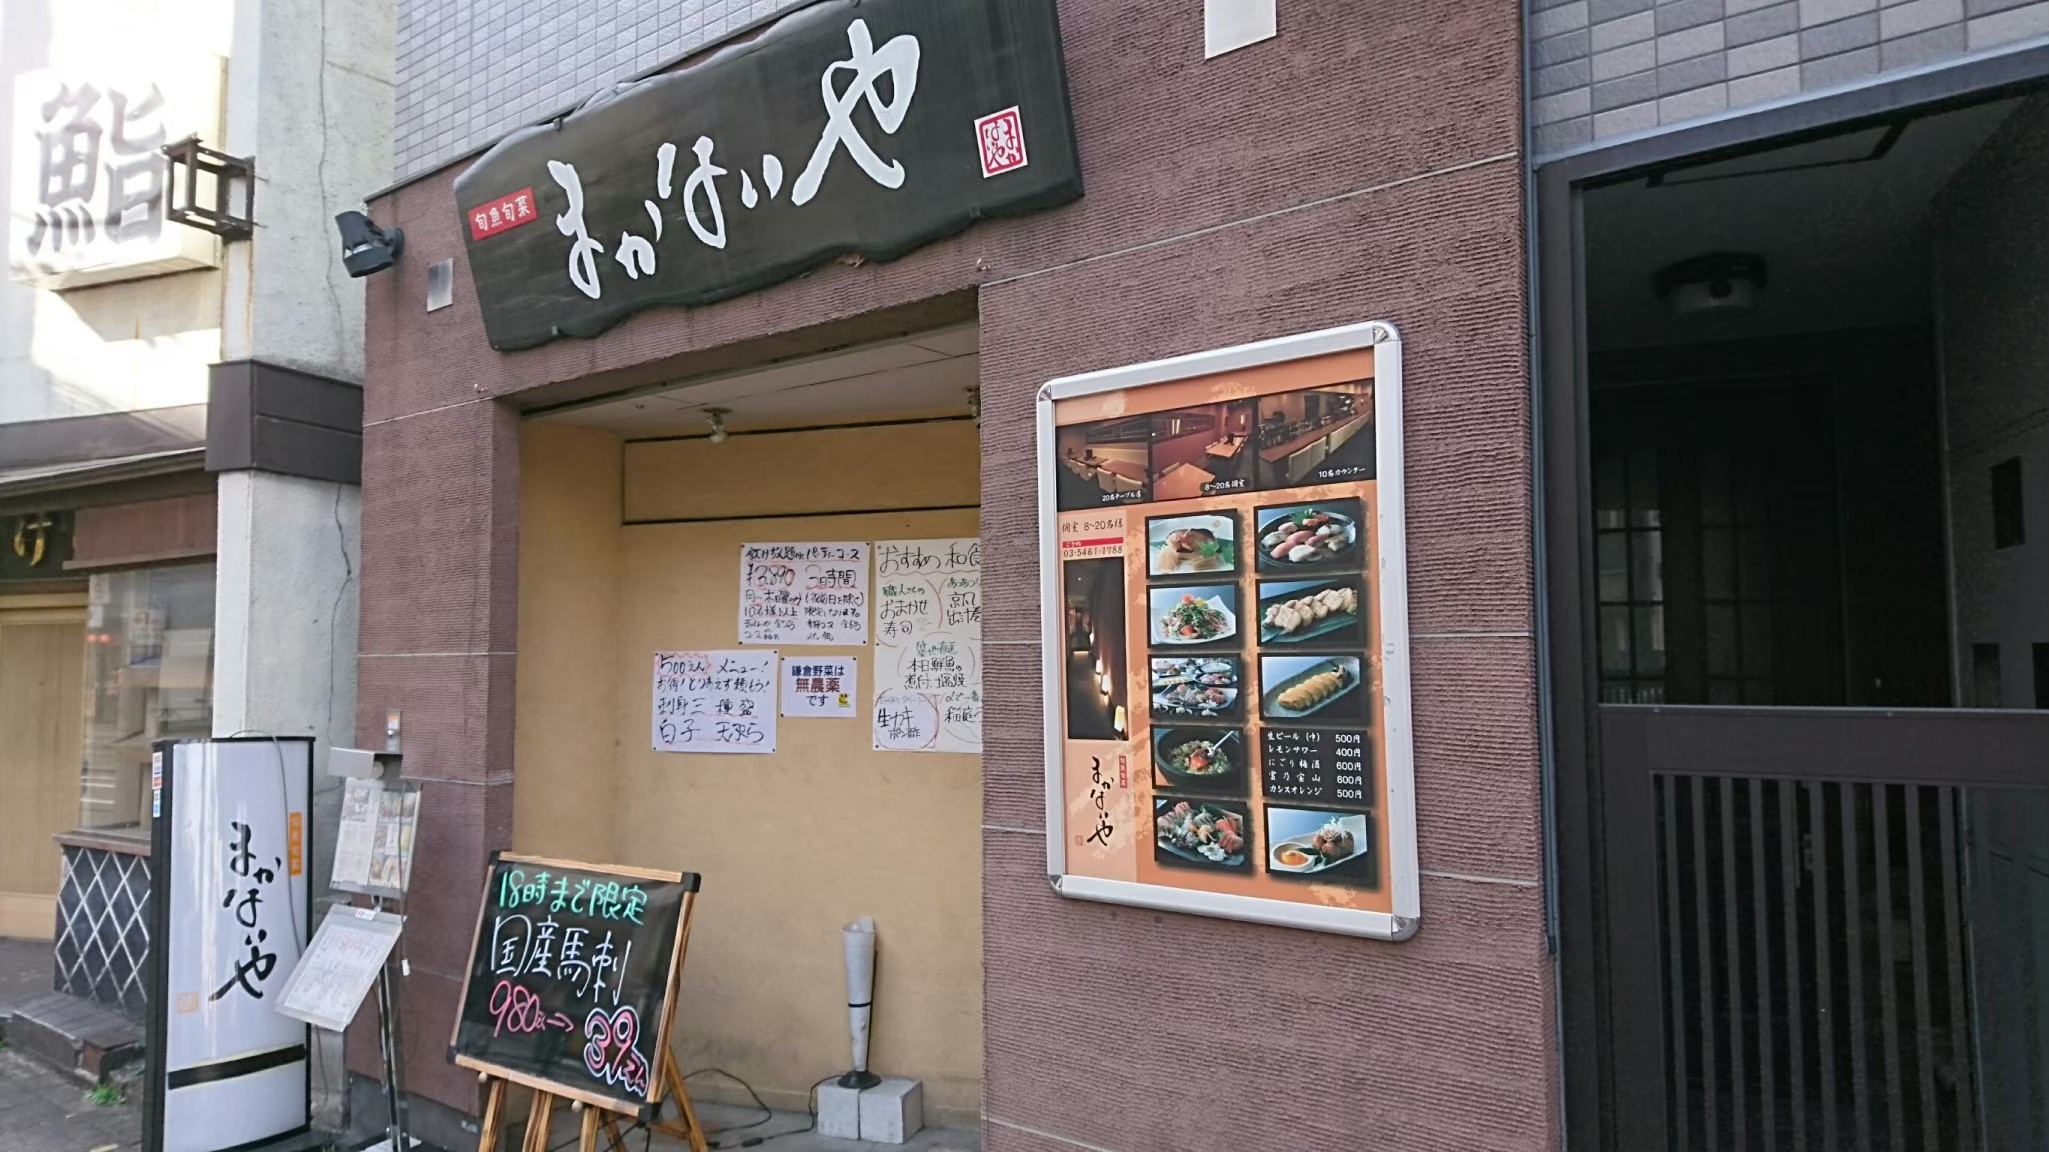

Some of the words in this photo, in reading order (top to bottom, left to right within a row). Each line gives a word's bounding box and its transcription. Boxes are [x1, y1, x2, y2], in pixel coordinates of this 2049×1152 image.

[27, 82, 166, 257] 鮨
[475, 195, 530, 231] 旬魚旬菜
[879, 545, 941, 573] おすすめ
[880, 599, 928, 620] おまかせ
[883, 620, 913, 638] 寿司
[791, 665, 845, 677] 鎌倉野菜は
[907, 656, 962, 672] 本日鮮魚の
[796, 677, 841, 693] 無農薬
[806, 694, 829, 707] です
[878, 706, 914, 728] 生カキ
[888, 727, 921, 740] ポン酢
[1267, 731, 1299, 741] 生ビール
[1335, 734, 1360, 744] 500円
[1269, 745, 1318, 754] レモンサワー
[1336, 748, 1361, 758] 400円
[1269, 758, 1320, 769] にごり梅酒
[1336, 761, 1361, 771] 600円
[1337, 775, 1362, 785] 600円
[1270, 784, 1323, 796] カシスオレンジ
[1337, 789, 1362, 799] 500円
[500, 870, 648, 926] 18時まで限定
[491, 915, 632, 1007] 国産馬刺
